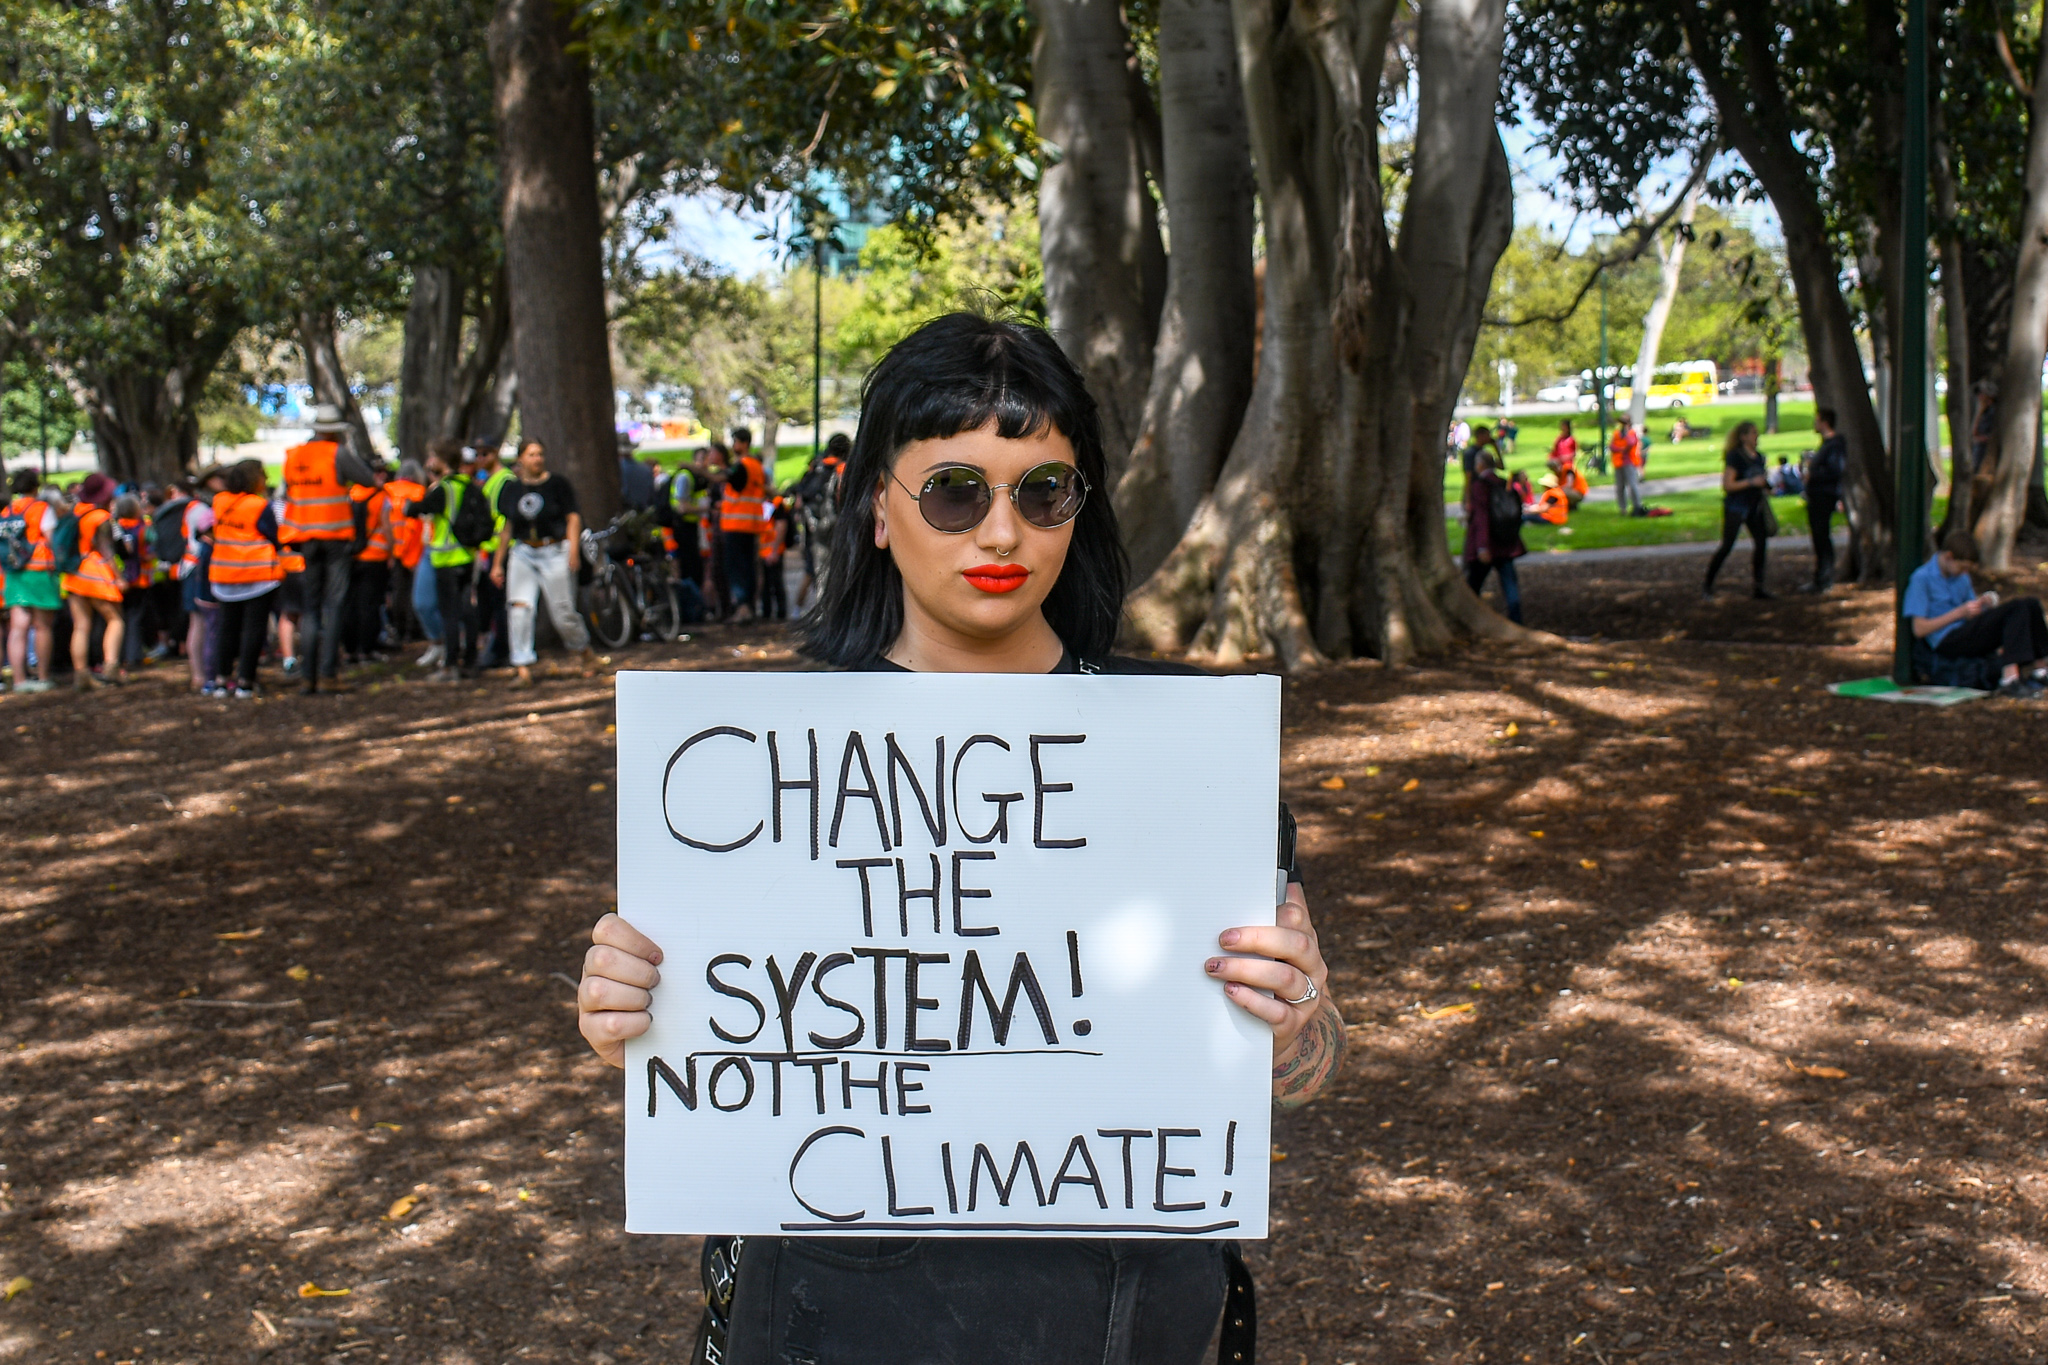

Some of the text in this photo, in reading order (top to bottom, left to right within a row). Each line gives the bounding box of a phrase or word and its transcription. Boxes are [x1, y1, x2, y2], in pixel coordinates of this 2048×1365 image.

[662, 725, 1087, 860] CHANGE
[835, 850, 1001, 938] THE
[705, 930, 1093, 1053] SYSTEM!
[789, 1120, 1239, 1223] CLIMATE!
